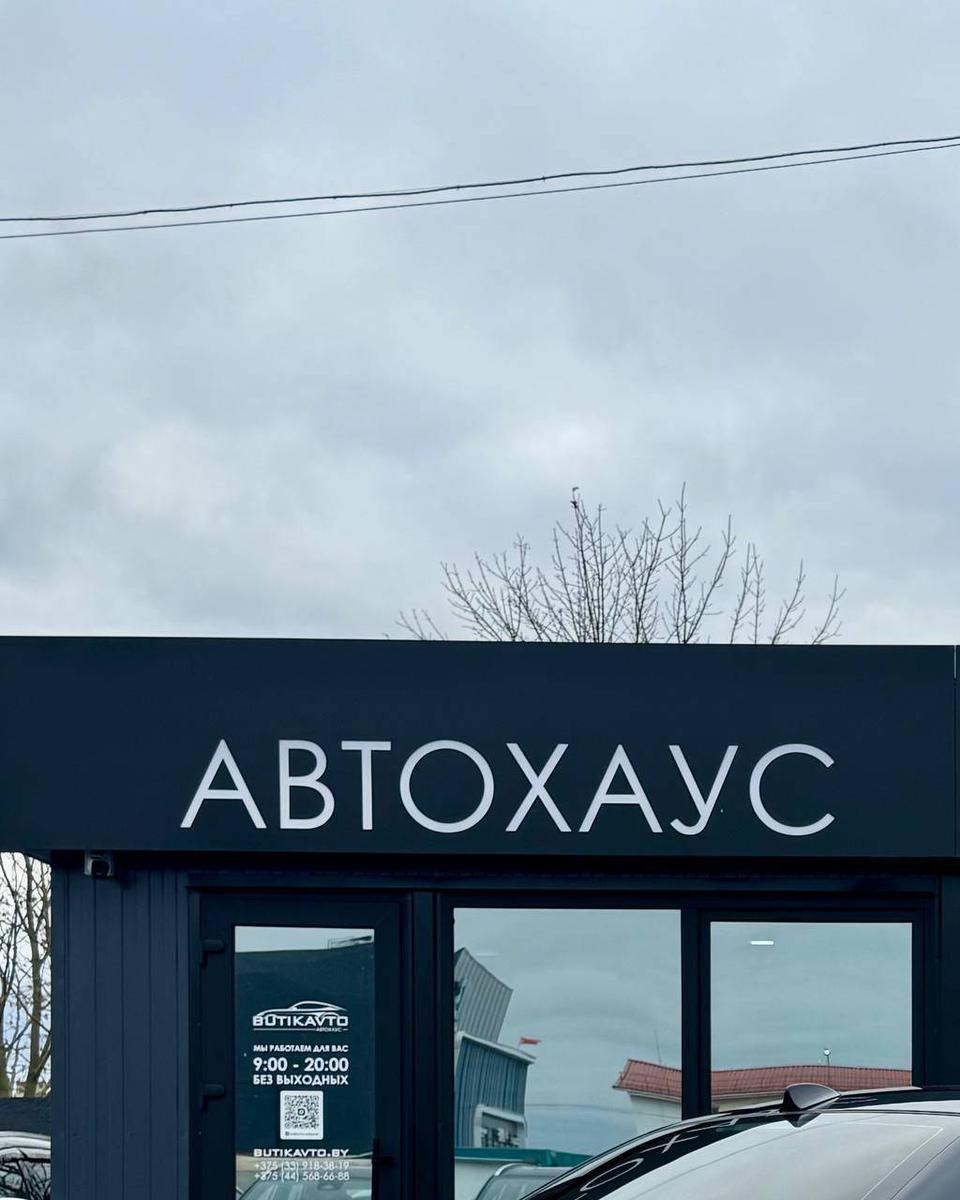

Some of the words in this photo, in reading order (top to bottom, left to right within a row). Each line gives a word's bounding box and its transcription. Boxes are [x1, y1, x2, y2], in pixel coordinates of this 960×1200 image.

[180, 738, 836, 836] АВТОХАУС
[252, 1015, 349, 1027] BUTIKAVTO
[269, 1045, 312, 1053] РАБОТАЕМ
[313, 1045, 330, 1053] ДЛЯ
[331, 1045, 349, 1053] ВАС
[253, 1057, 288, 1071] 9:00
[304, 1057, 349, 1071] 20:00
[253, 1075, 273, 1085] БЕЗ
[276, 1075, 349, 1086] ВЫХОДНЫХ
[253, 1148, 349, 1157] BUTIKAVTO.BY
[254, 1161, 278, 1170] +375
[281, 1160, 299, 1172] (33)
[254, 1171, 278, 1180] +375
[281, 1171, 299, 1182] (44)
[302, 1171, 350, 1180] 568-66-88
